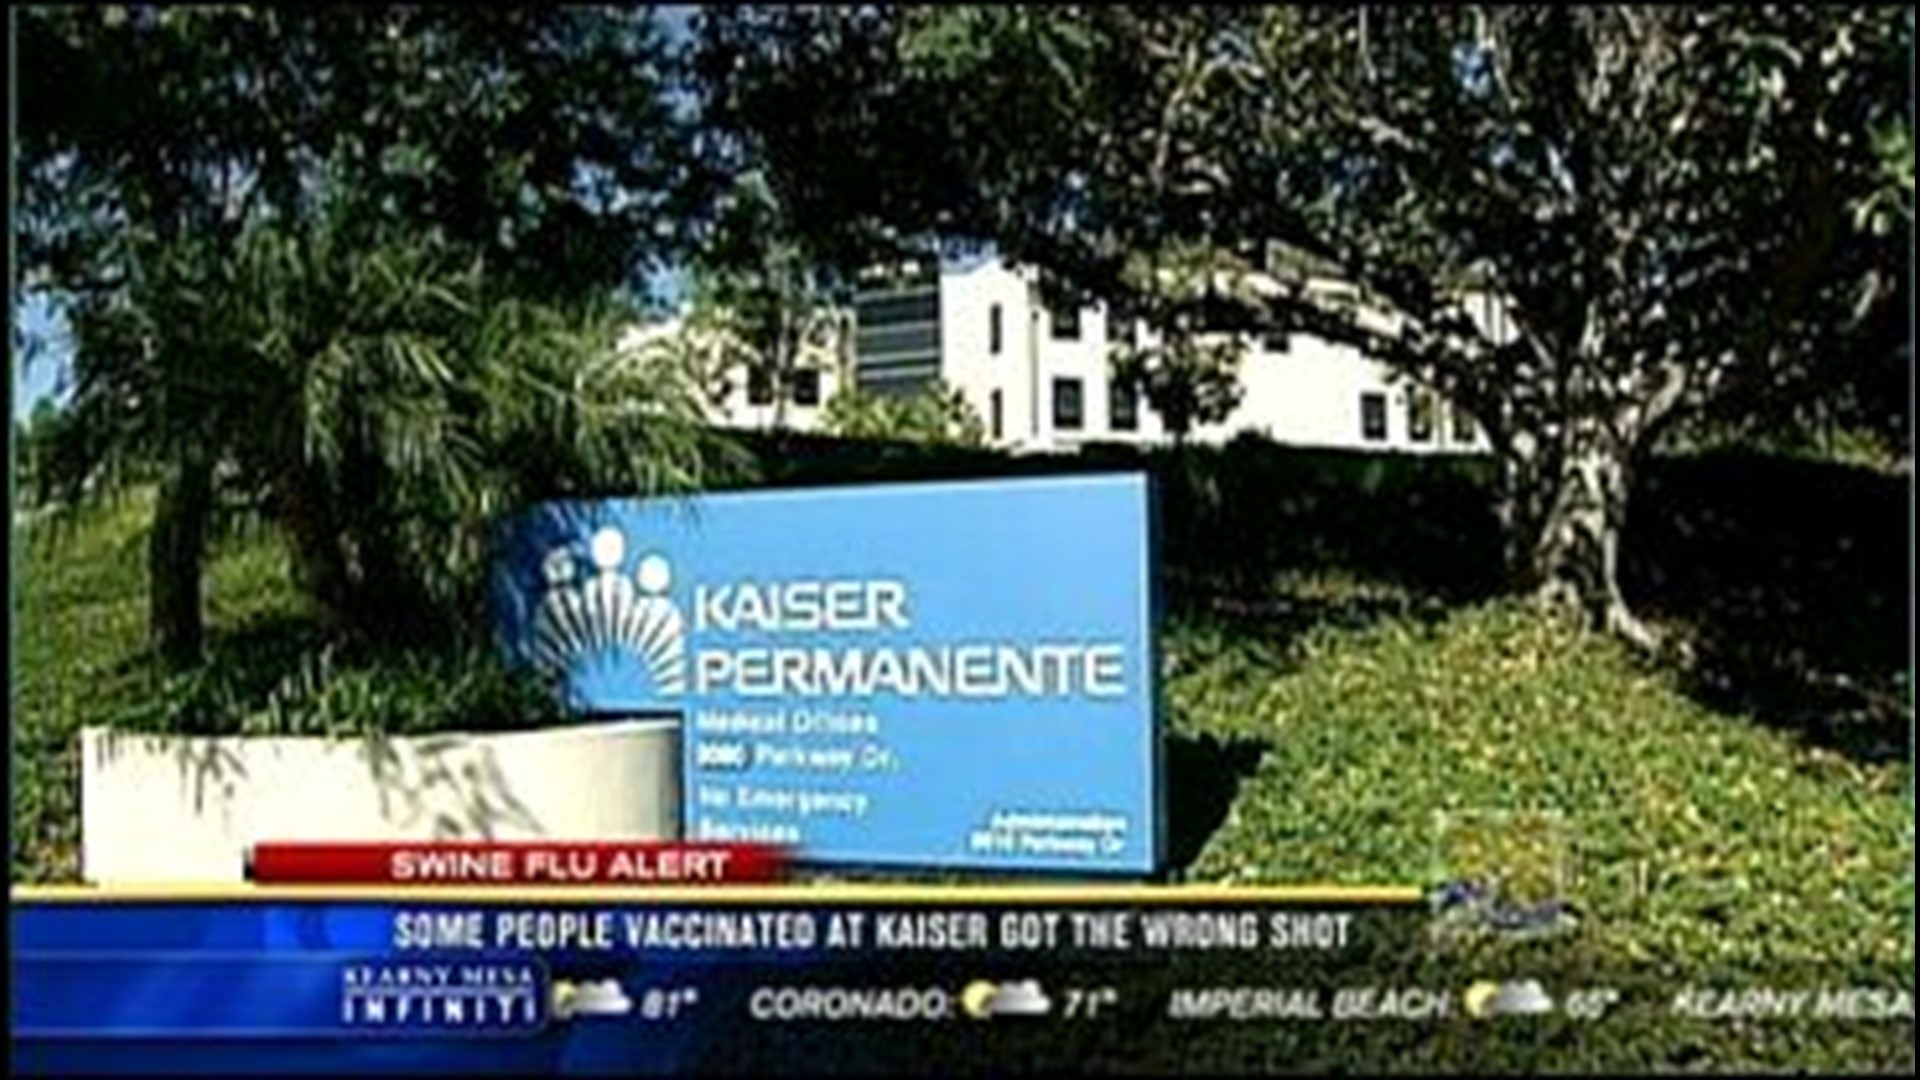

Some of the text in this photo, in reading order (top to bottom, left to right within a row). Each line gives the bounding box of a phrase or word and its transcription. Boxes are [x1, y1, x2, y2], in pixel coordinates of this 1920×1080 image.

[695, 580, 910, 630] KAISER
[696, 643, 1128, 696] PERMANENTE
[697, 708, 786, 734] Medical
[735, 786, 869, 818] Emergency
